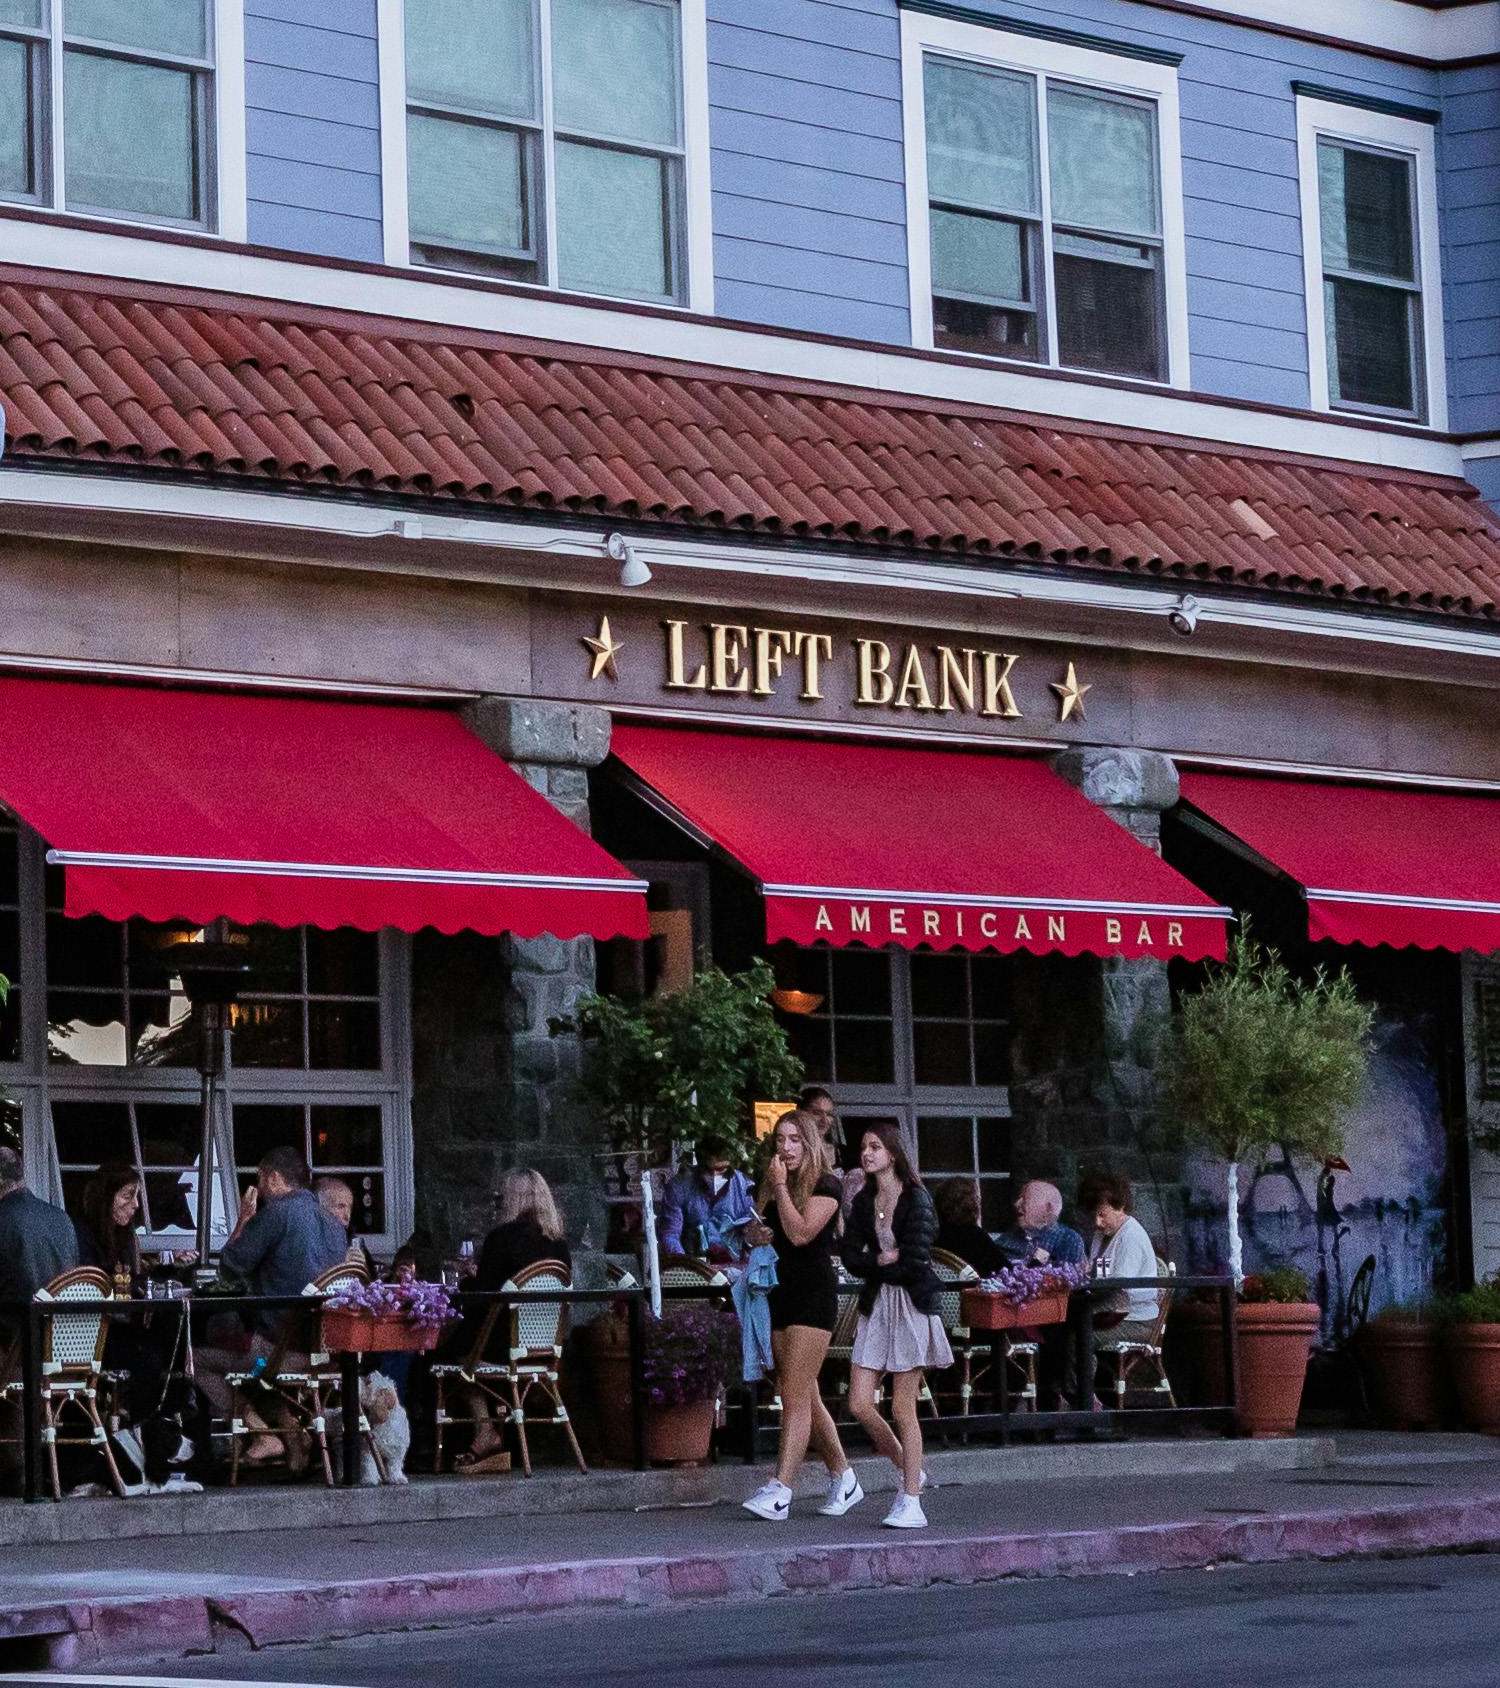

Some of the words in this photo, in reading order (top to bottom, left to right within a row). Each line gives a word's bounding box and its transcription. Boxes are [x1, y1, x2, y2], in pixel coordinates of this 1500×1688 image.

[665, 619, 833, 700] LEFT
[855, 637, 1024, 718] BANK
[814, 904, 1066, 943] AMERICAN
[1105, 918, 1184, 947] BAR
